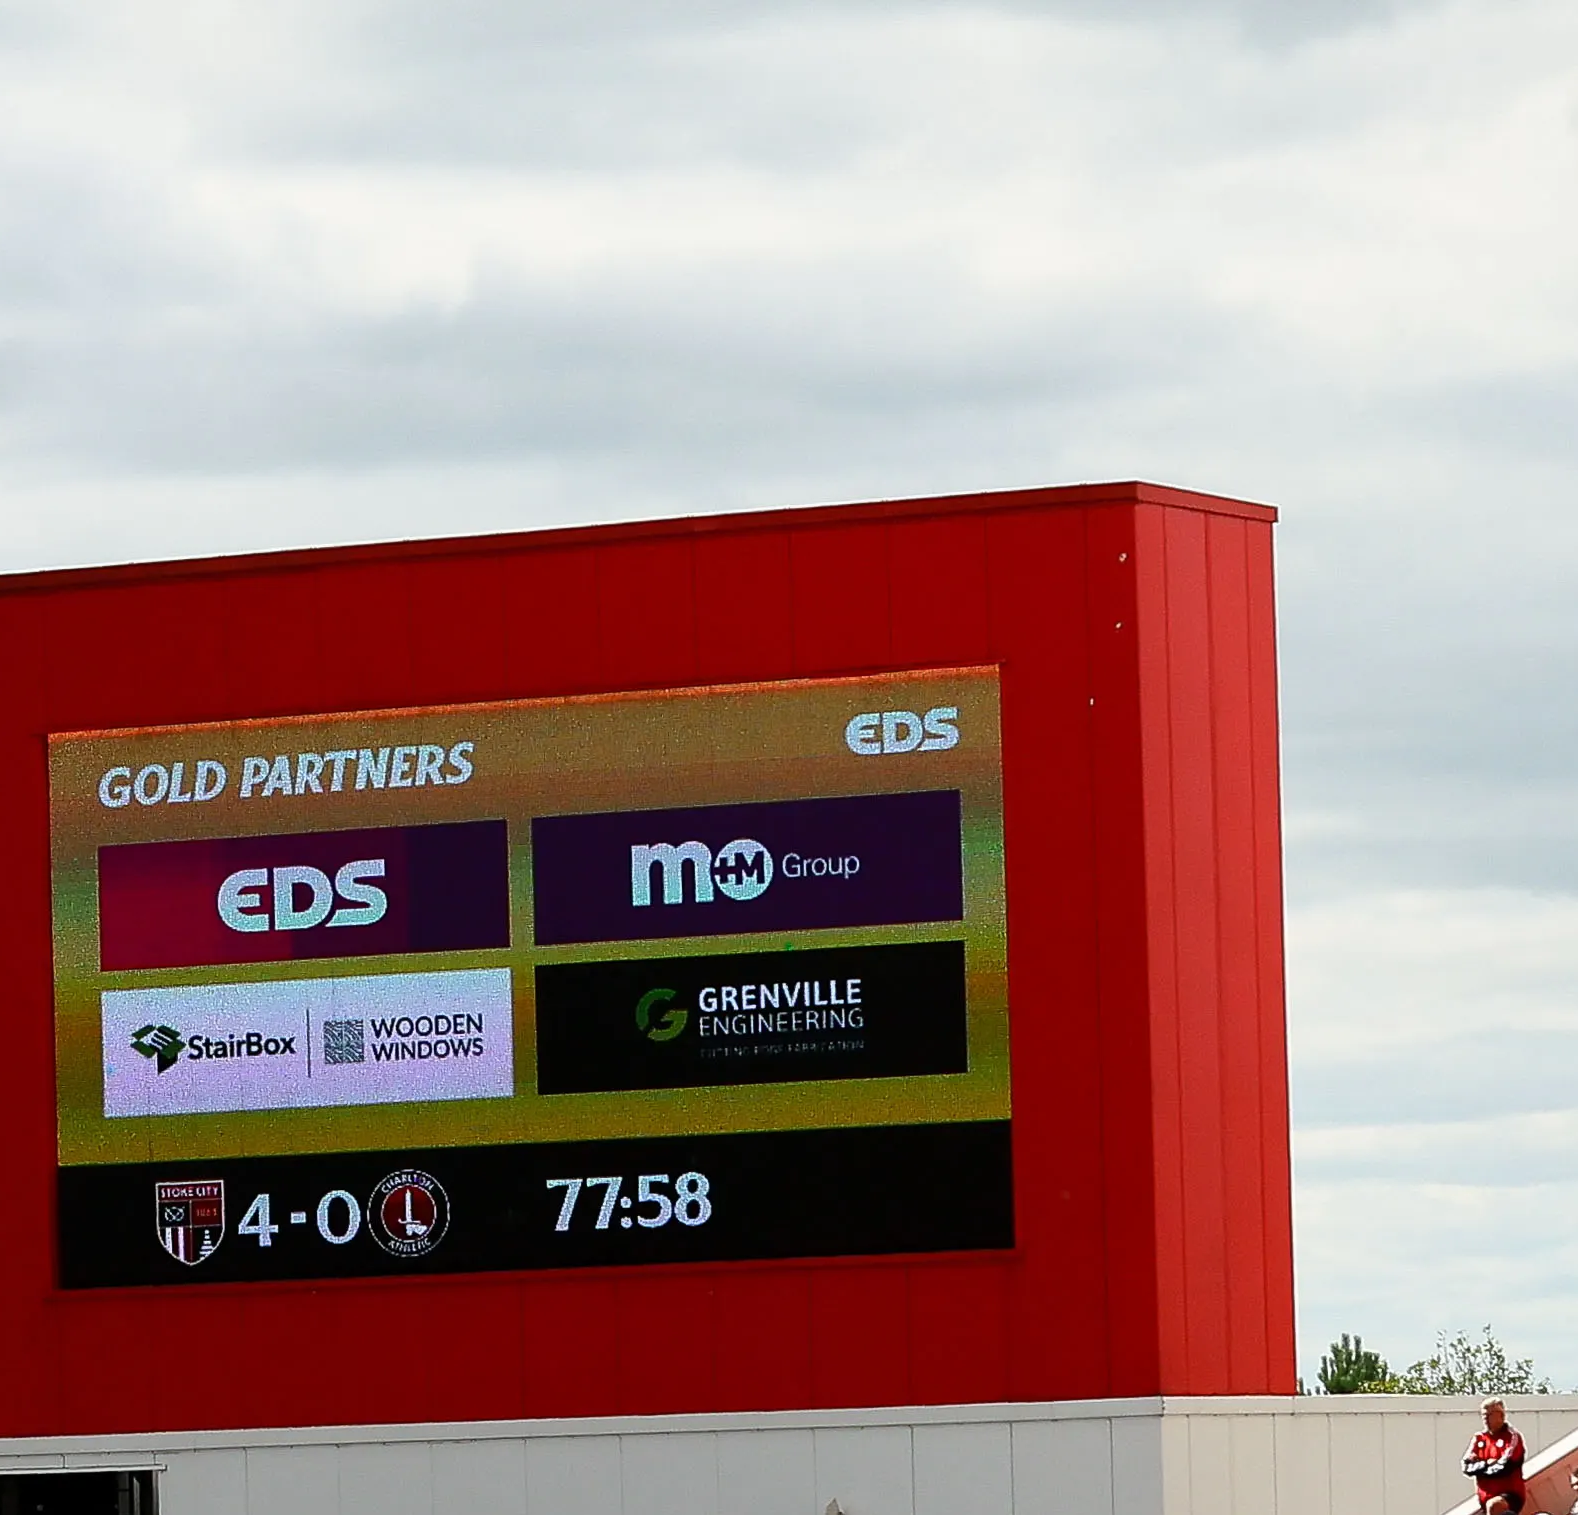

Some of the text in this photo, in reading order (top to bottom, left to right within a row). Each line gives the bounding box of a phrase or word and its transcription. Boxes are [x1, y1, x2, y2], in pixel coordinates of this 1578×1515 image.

[844, 706, 961, 756] EDS
[98, 741, 475, 808] GOLD PARTNERS
[782, 853, 860, 879] Group
[218, 858, 389, 932] EDS
[698, 978, 862, 1013] GRENVILLE
[370, 1012, 484, 1040] WOODEN
[698, 1007, 864, 1037] ENGINEERING
[187, 1032, 297, 1060] StairBox
[371, 1037, 484, 1063] WINDOWS
[160, 1186, 219, 1198] STOKE CITY
[380, 1173, 435, 1194] CHARLTON
[545, 1171, 712, 1231] 77:58
